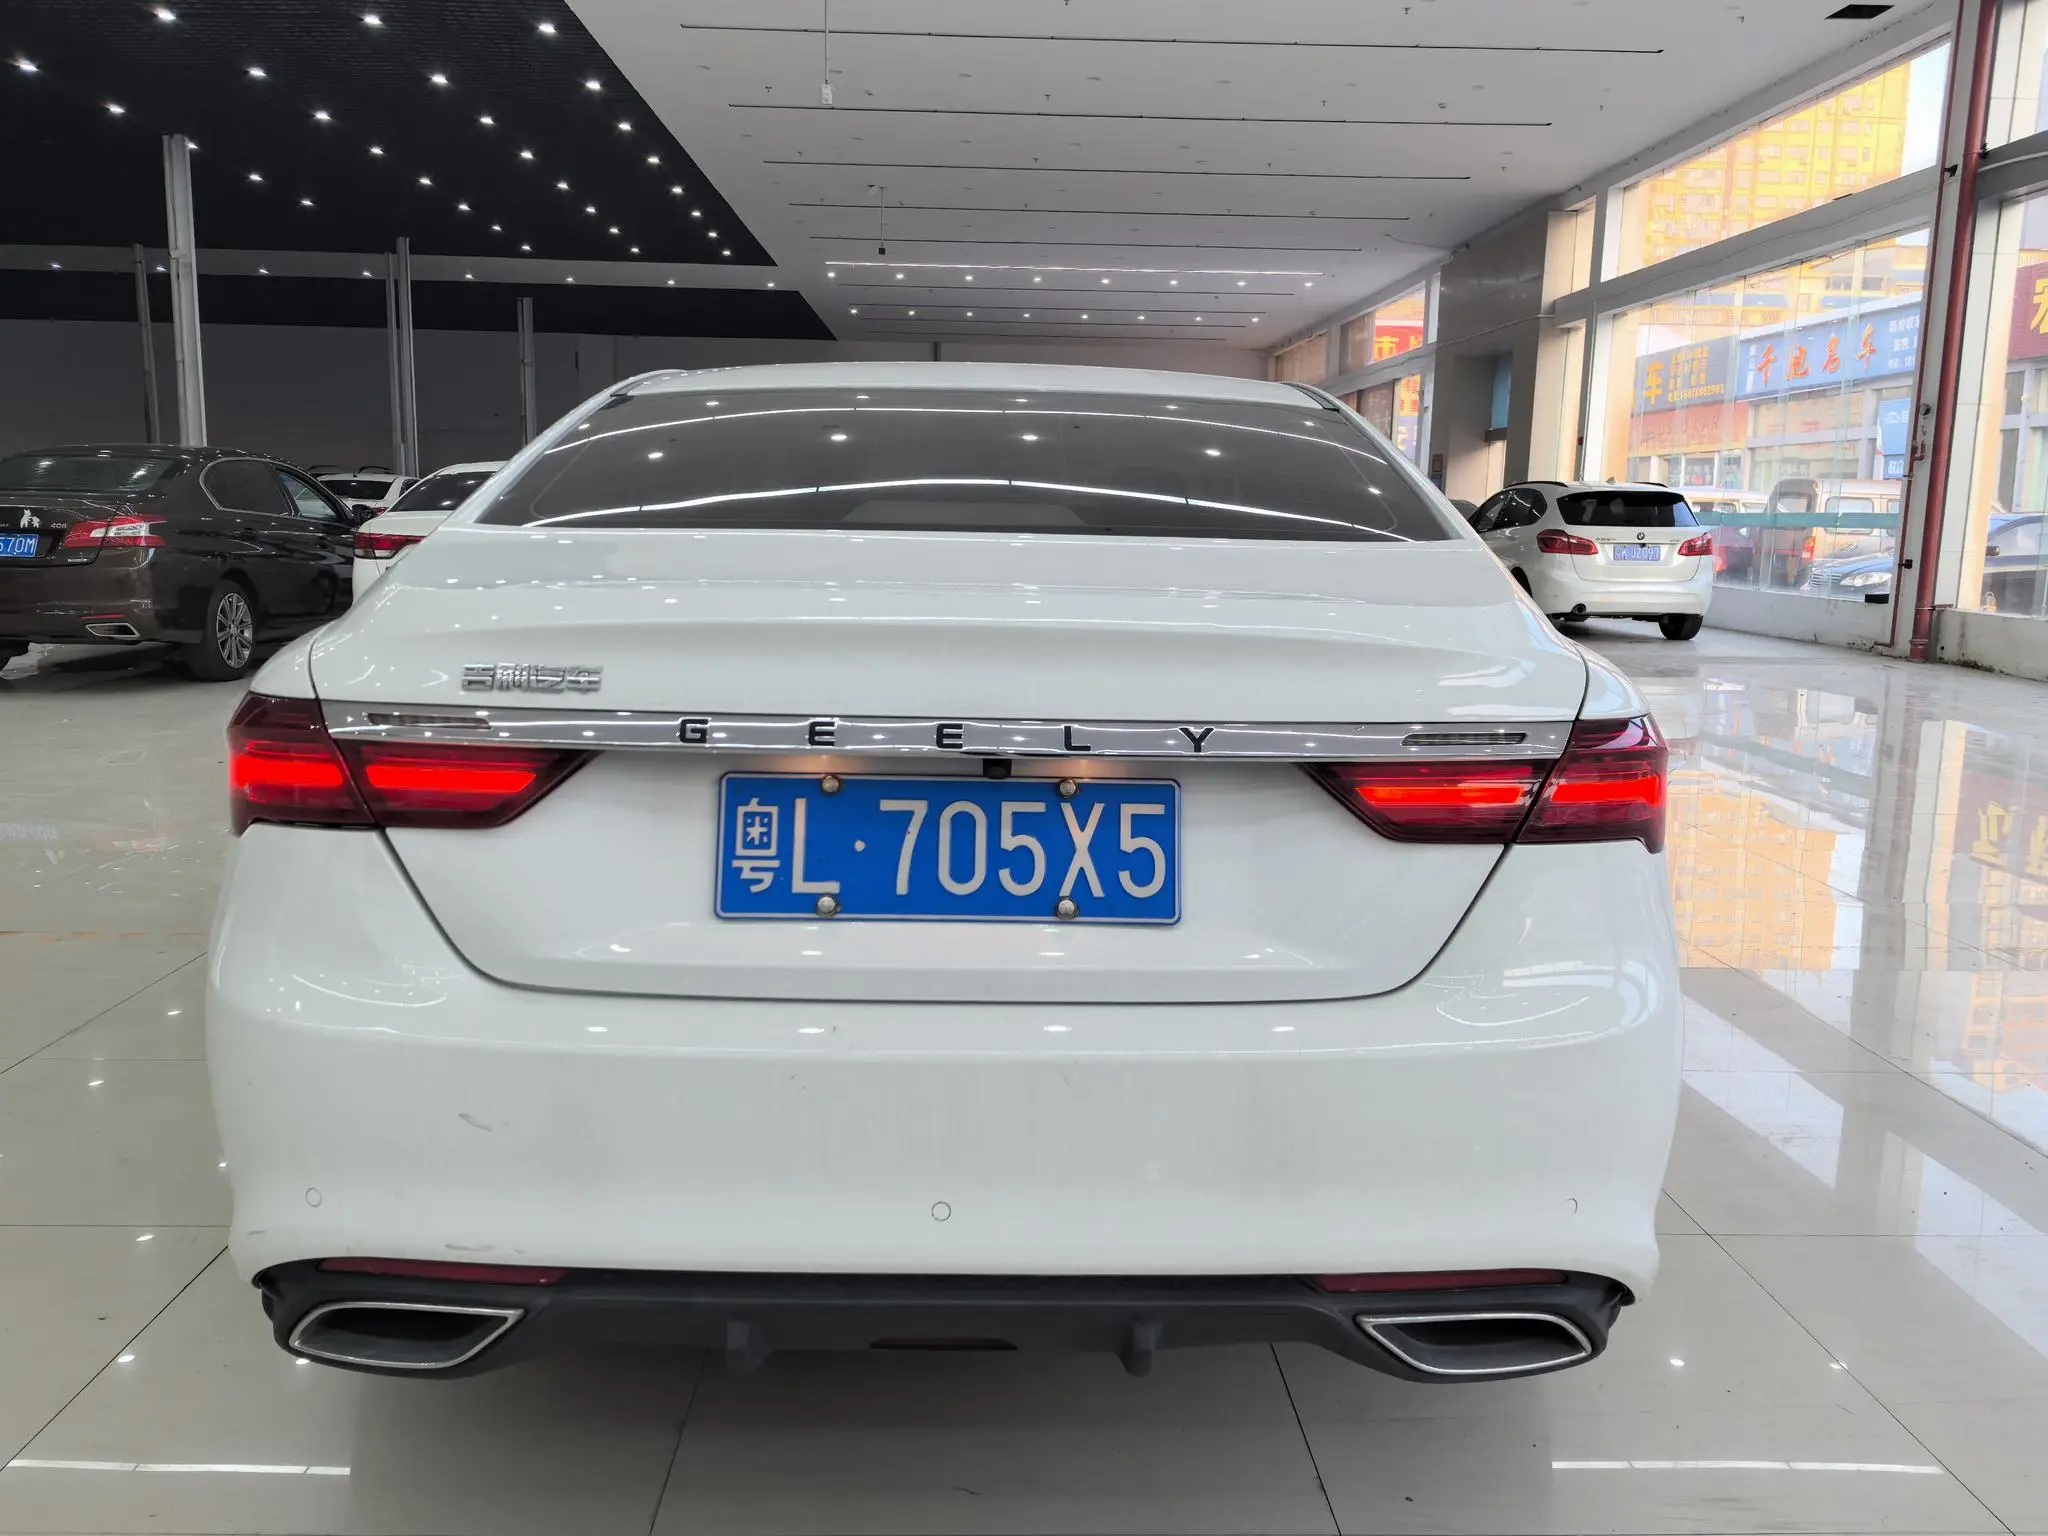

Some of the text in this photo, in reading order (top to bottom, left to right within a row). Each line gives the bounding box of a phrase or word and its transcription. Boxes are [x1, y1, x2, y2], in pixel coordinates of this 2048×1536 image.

[462, 663, 603, 694] 吉利汽车
[679, 718, 1215, 753] GEELY
